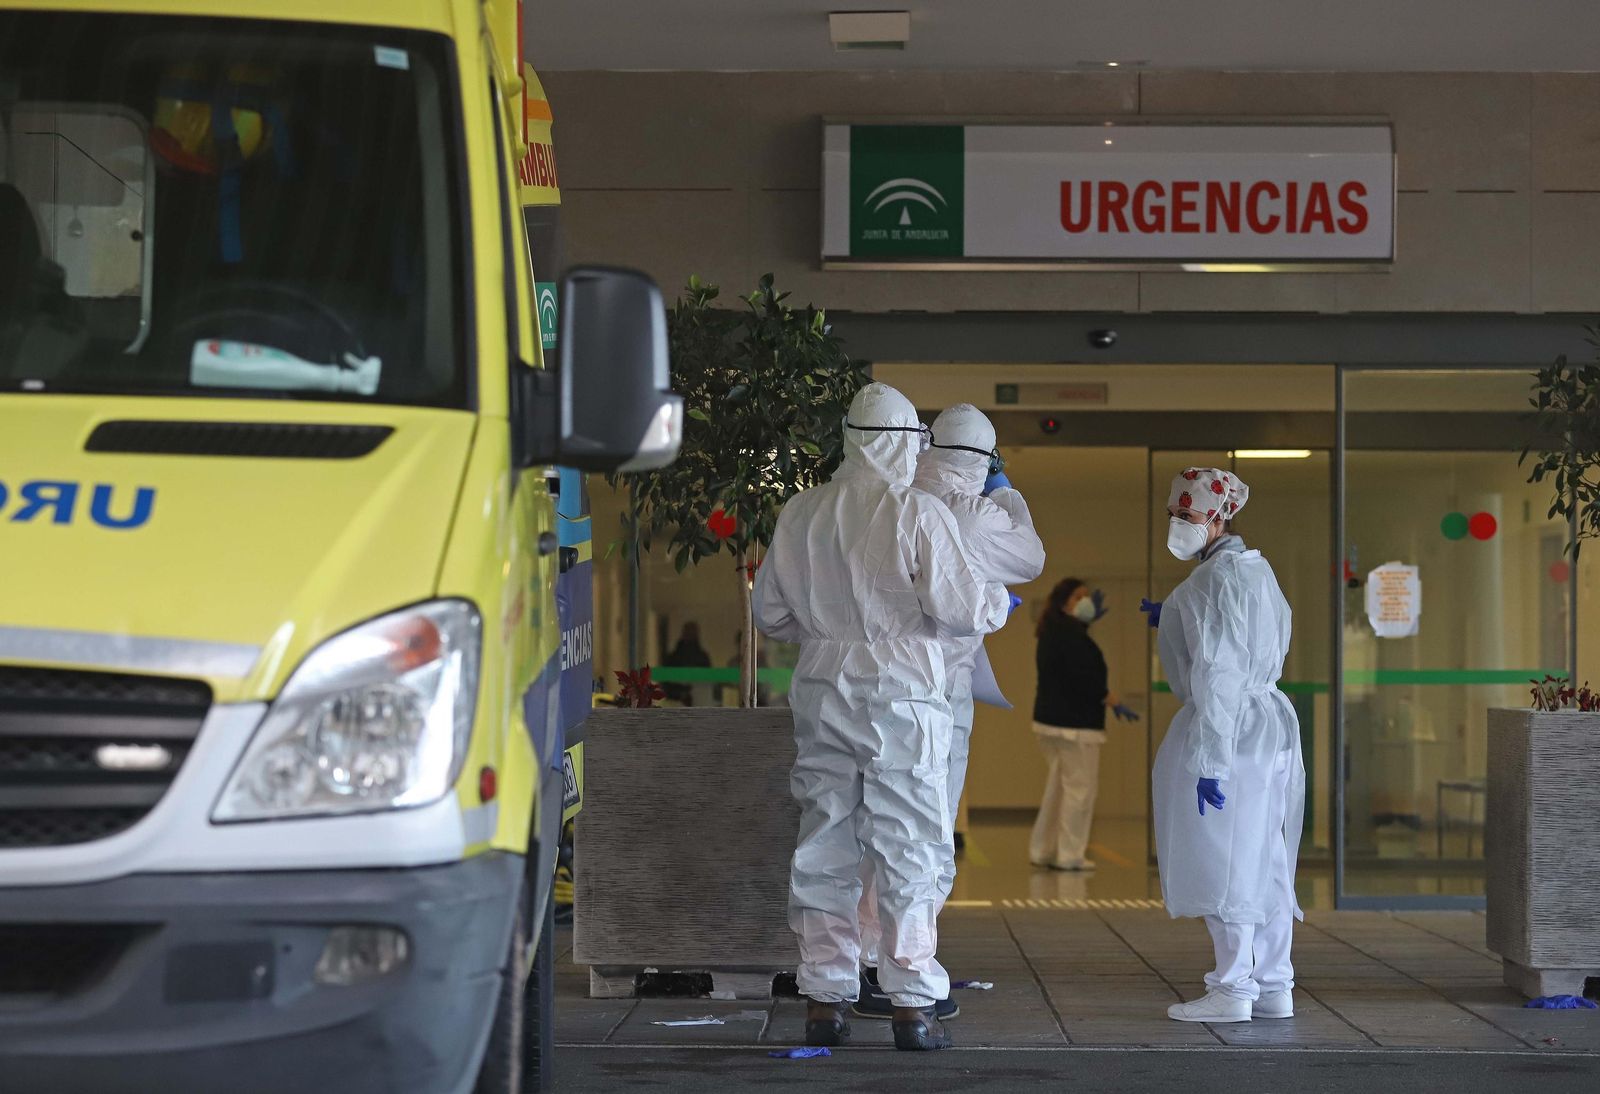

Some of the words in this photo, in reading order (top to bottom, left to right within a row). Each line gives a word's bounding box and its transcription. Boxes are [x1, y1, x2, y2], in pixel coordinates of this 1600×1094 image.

[1060, 180, 1369, 234] URGENCIAS
[862, 230, 888, 240] JUNTA
[891, 230, 902, 240] DE
